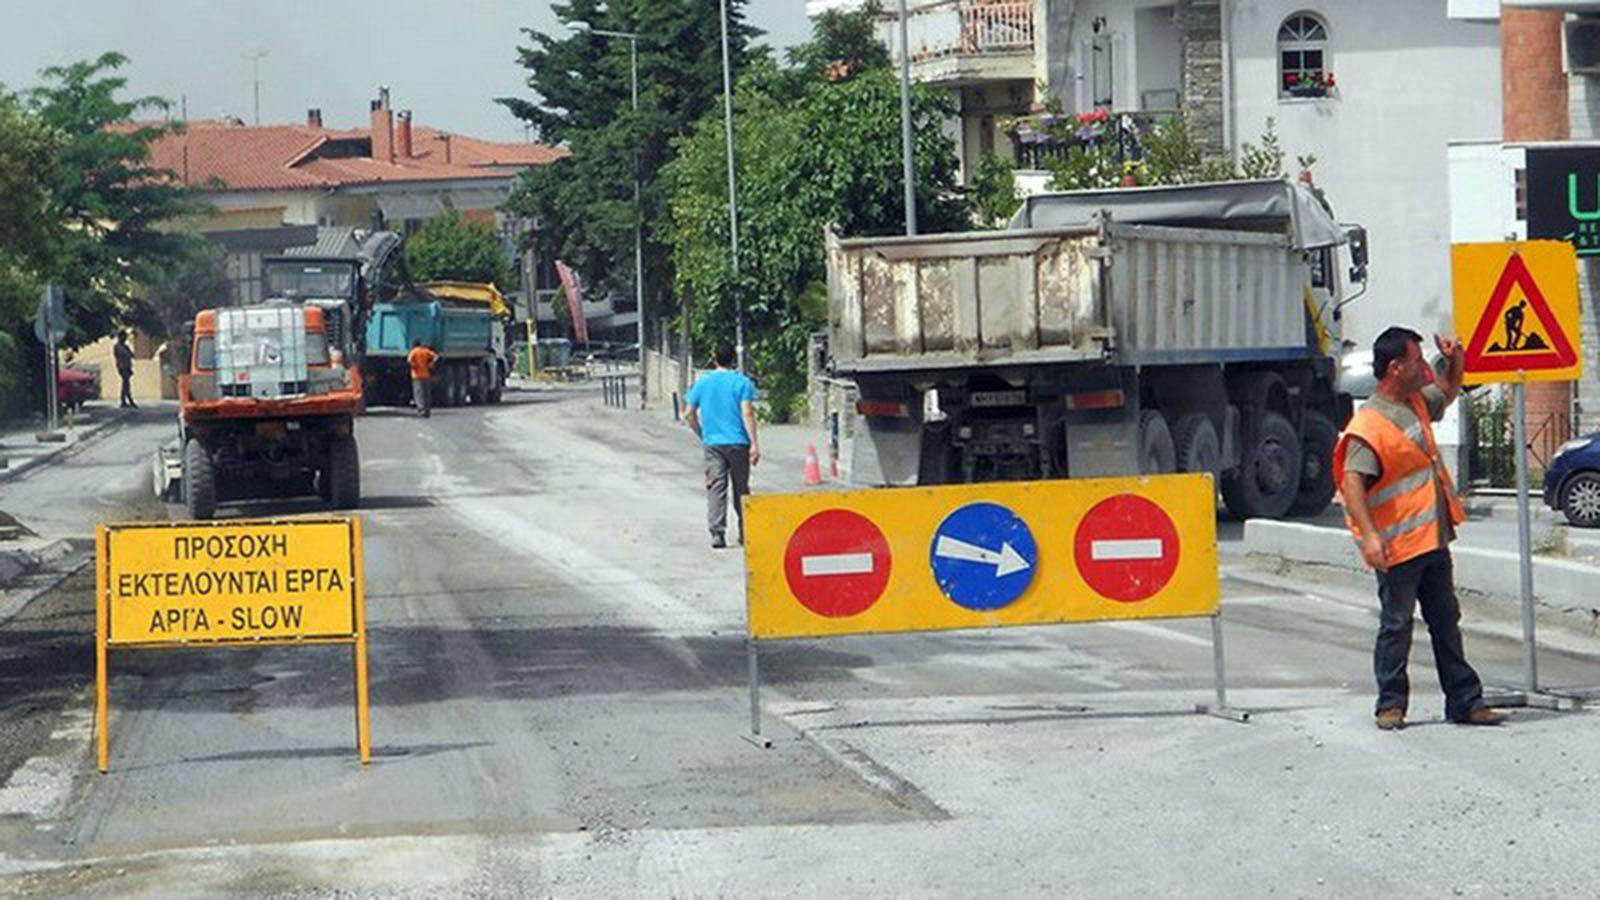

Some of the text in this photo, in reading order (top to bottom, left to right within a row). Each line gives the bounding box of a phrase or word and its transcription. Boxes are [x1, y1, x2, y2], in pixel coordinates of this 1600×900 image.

[174, 534, 288, 560] ΠΡΟΣΟΧΗ
[118, 569, 344, 597] ΕΚΤΕΛΟΥΝΤΑΙ ΕΡΓΑ
[231, 606, 303, 631] SLOW
